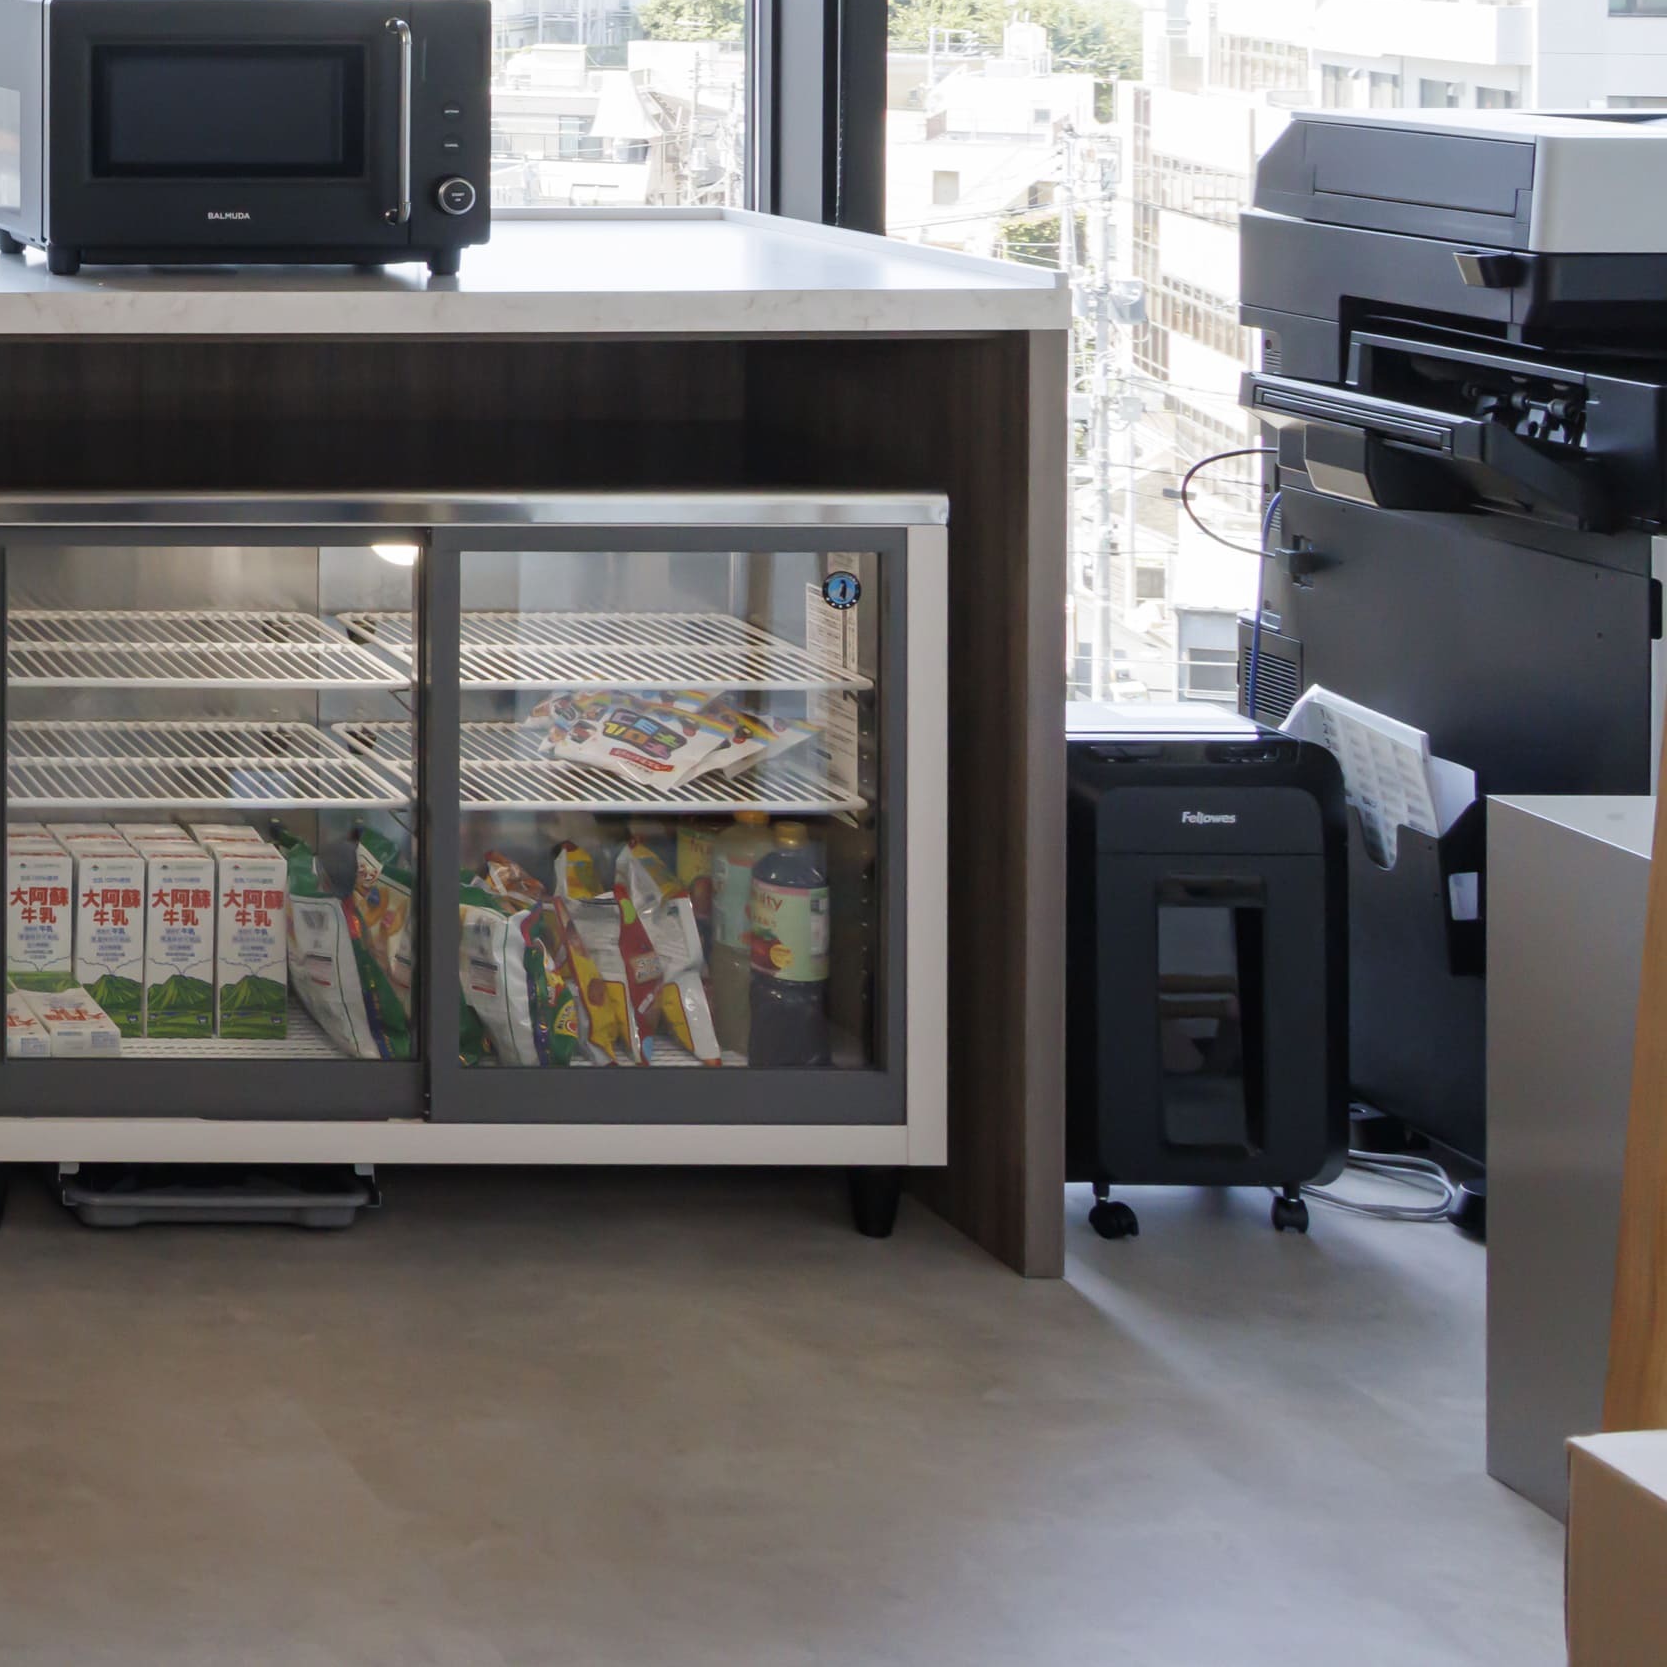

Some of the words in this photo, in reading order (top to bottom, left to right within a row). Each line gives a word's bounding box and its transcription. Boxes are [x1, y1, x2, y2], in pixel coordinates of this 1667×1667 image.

[207, 211, 251, 220] BALMUDA
[1181, 811, 1236, 825] Fellowes
[10, 886, 69, 907] 大阿蘇
[82, 888, 141, 908] 大阿蘇
[152, 888, 212, 909] 大阿蘇
[223, 888, 284, 910] 大阿蘇
[21, 907, 57, 924] 牛乳
[93, 909, 129, 926] 牛乳
[162, 909, 199, 926] 牛乳
[234, 909, 272, 927] 牛乳
